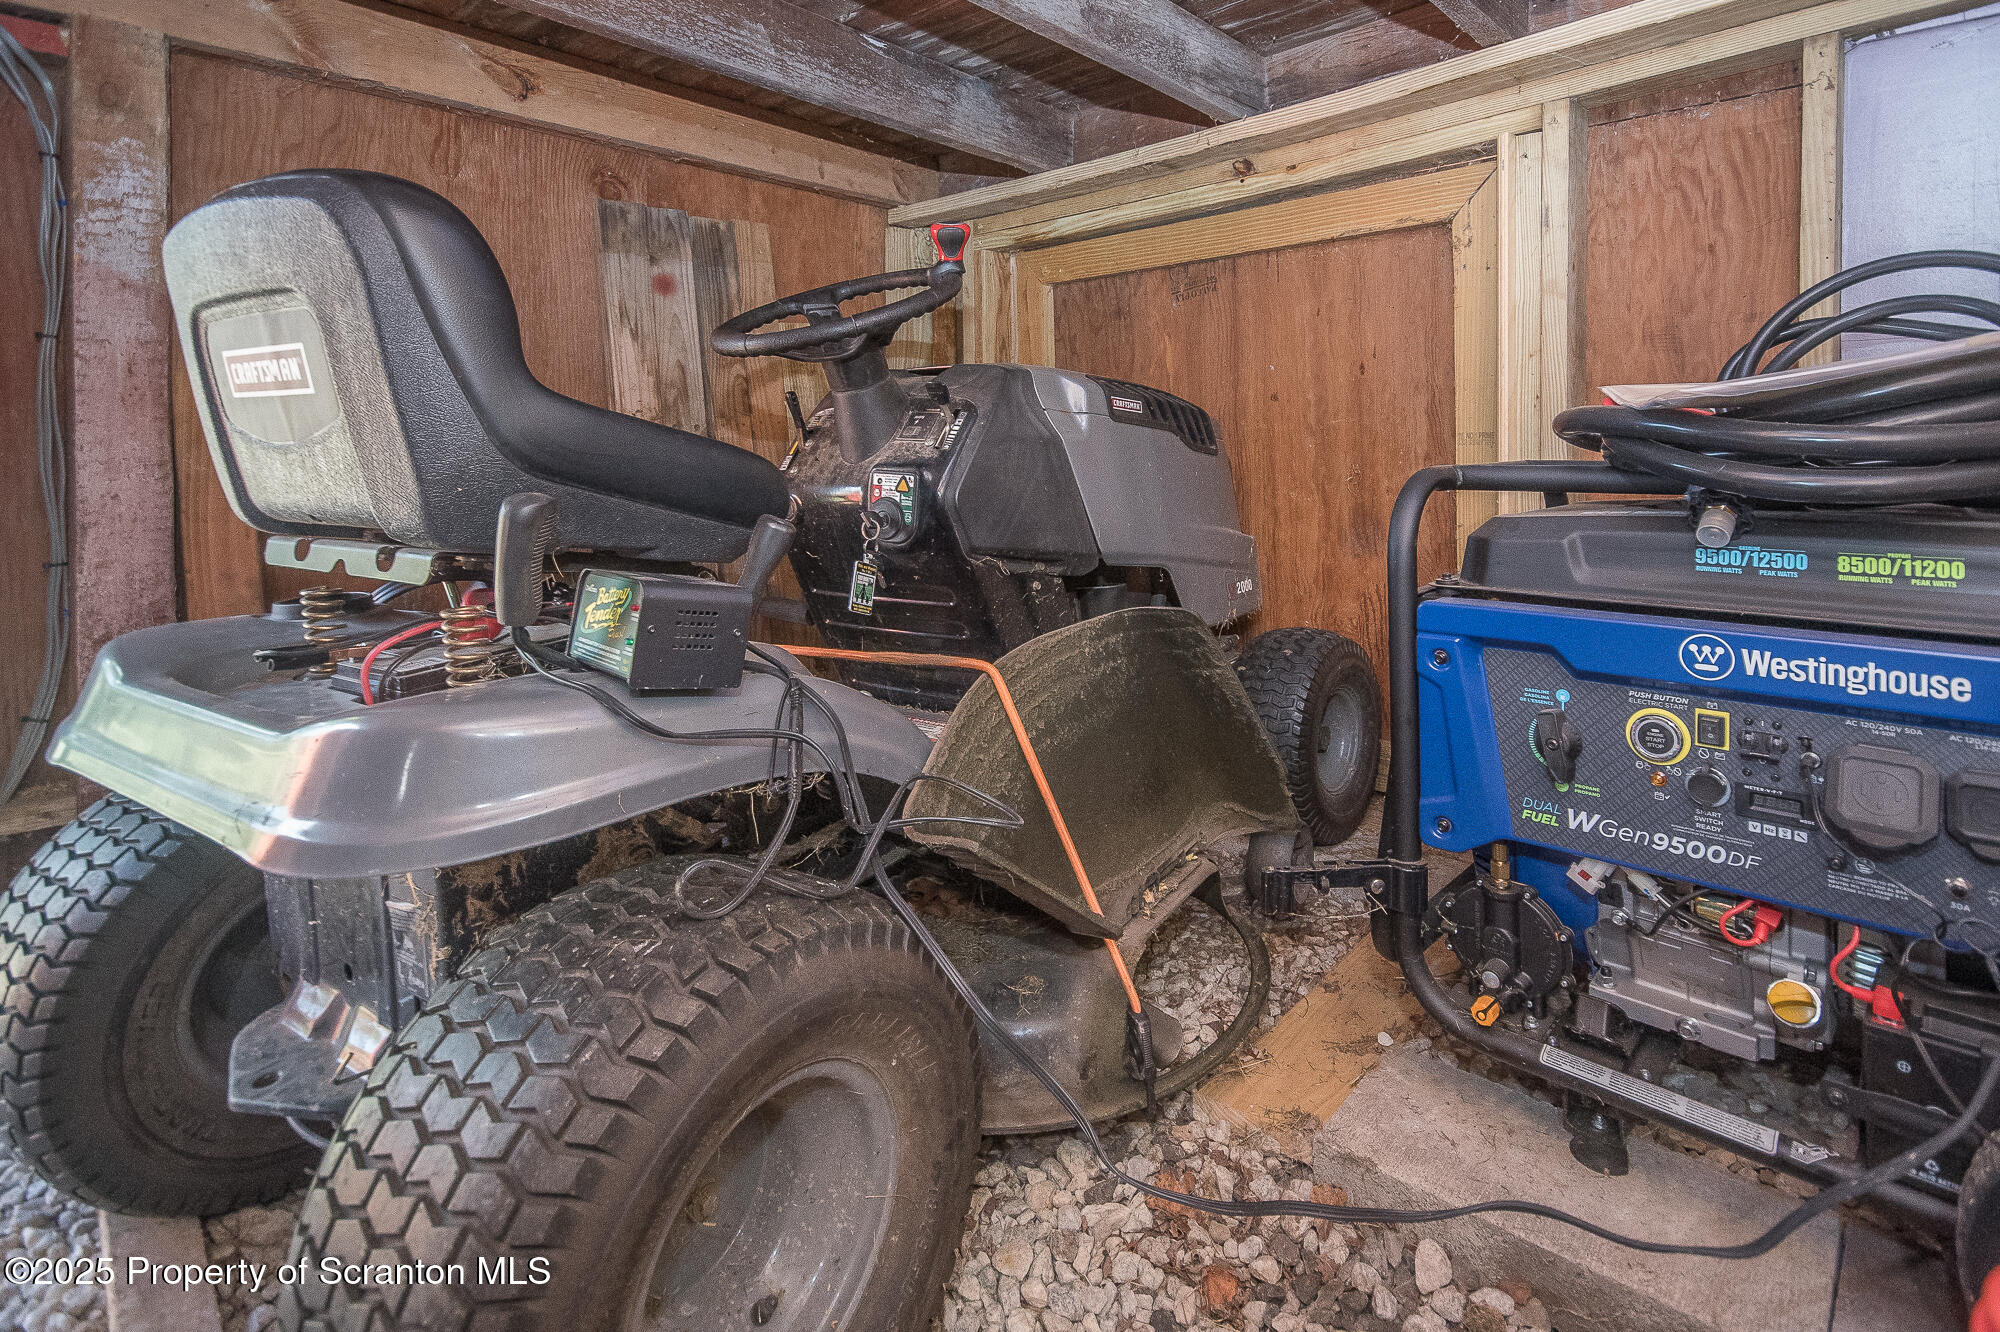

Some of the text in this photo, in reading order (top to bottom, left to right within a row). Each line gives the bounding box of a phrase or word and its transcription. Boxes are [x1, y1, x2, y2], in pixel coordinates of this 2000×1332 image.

[230, 357, 302, 385] CRAFTSMAN
[1113, 399, 1141, 410] CRAFTSMAN
[1694, 547, 1809, 571] 9500/12500
[1722, 567, 1743, 575] WATTS
[1758, 569, 1777, 577] PEAK
[1836, 555, 1966, 580] 8500/11200
[1869, 576, 1893, 585] WATTS
[1911, 578, 1957, 588] PEAK WATTS
[597, 586, 632, 606] Battery
[584, 601, 623, 630] Tender
[1740, 647, 1973, 703] Westinghouse
[1628, 690, 1689, 704] PUSH BUTTON
[1628, 698, 1689, 711] ELECTRIC START
[1845, 719, 1858, 727] AC
[1860, 721, 1902, 733] 120/240V
[1645, 736, 1666, 744] START
[1949, 735, 1963, 743] AC
[1574, 783, 1601, 793] PROPANE
[1574, 788, 1601, 798] PROPANO
[1522, 796, 1562, 815] DUAL
[1521, 809, 1560, 827] FUEL
[1693, 815, 1724, 827] SWITCH
[1695, 822, 1722, 833] READY
